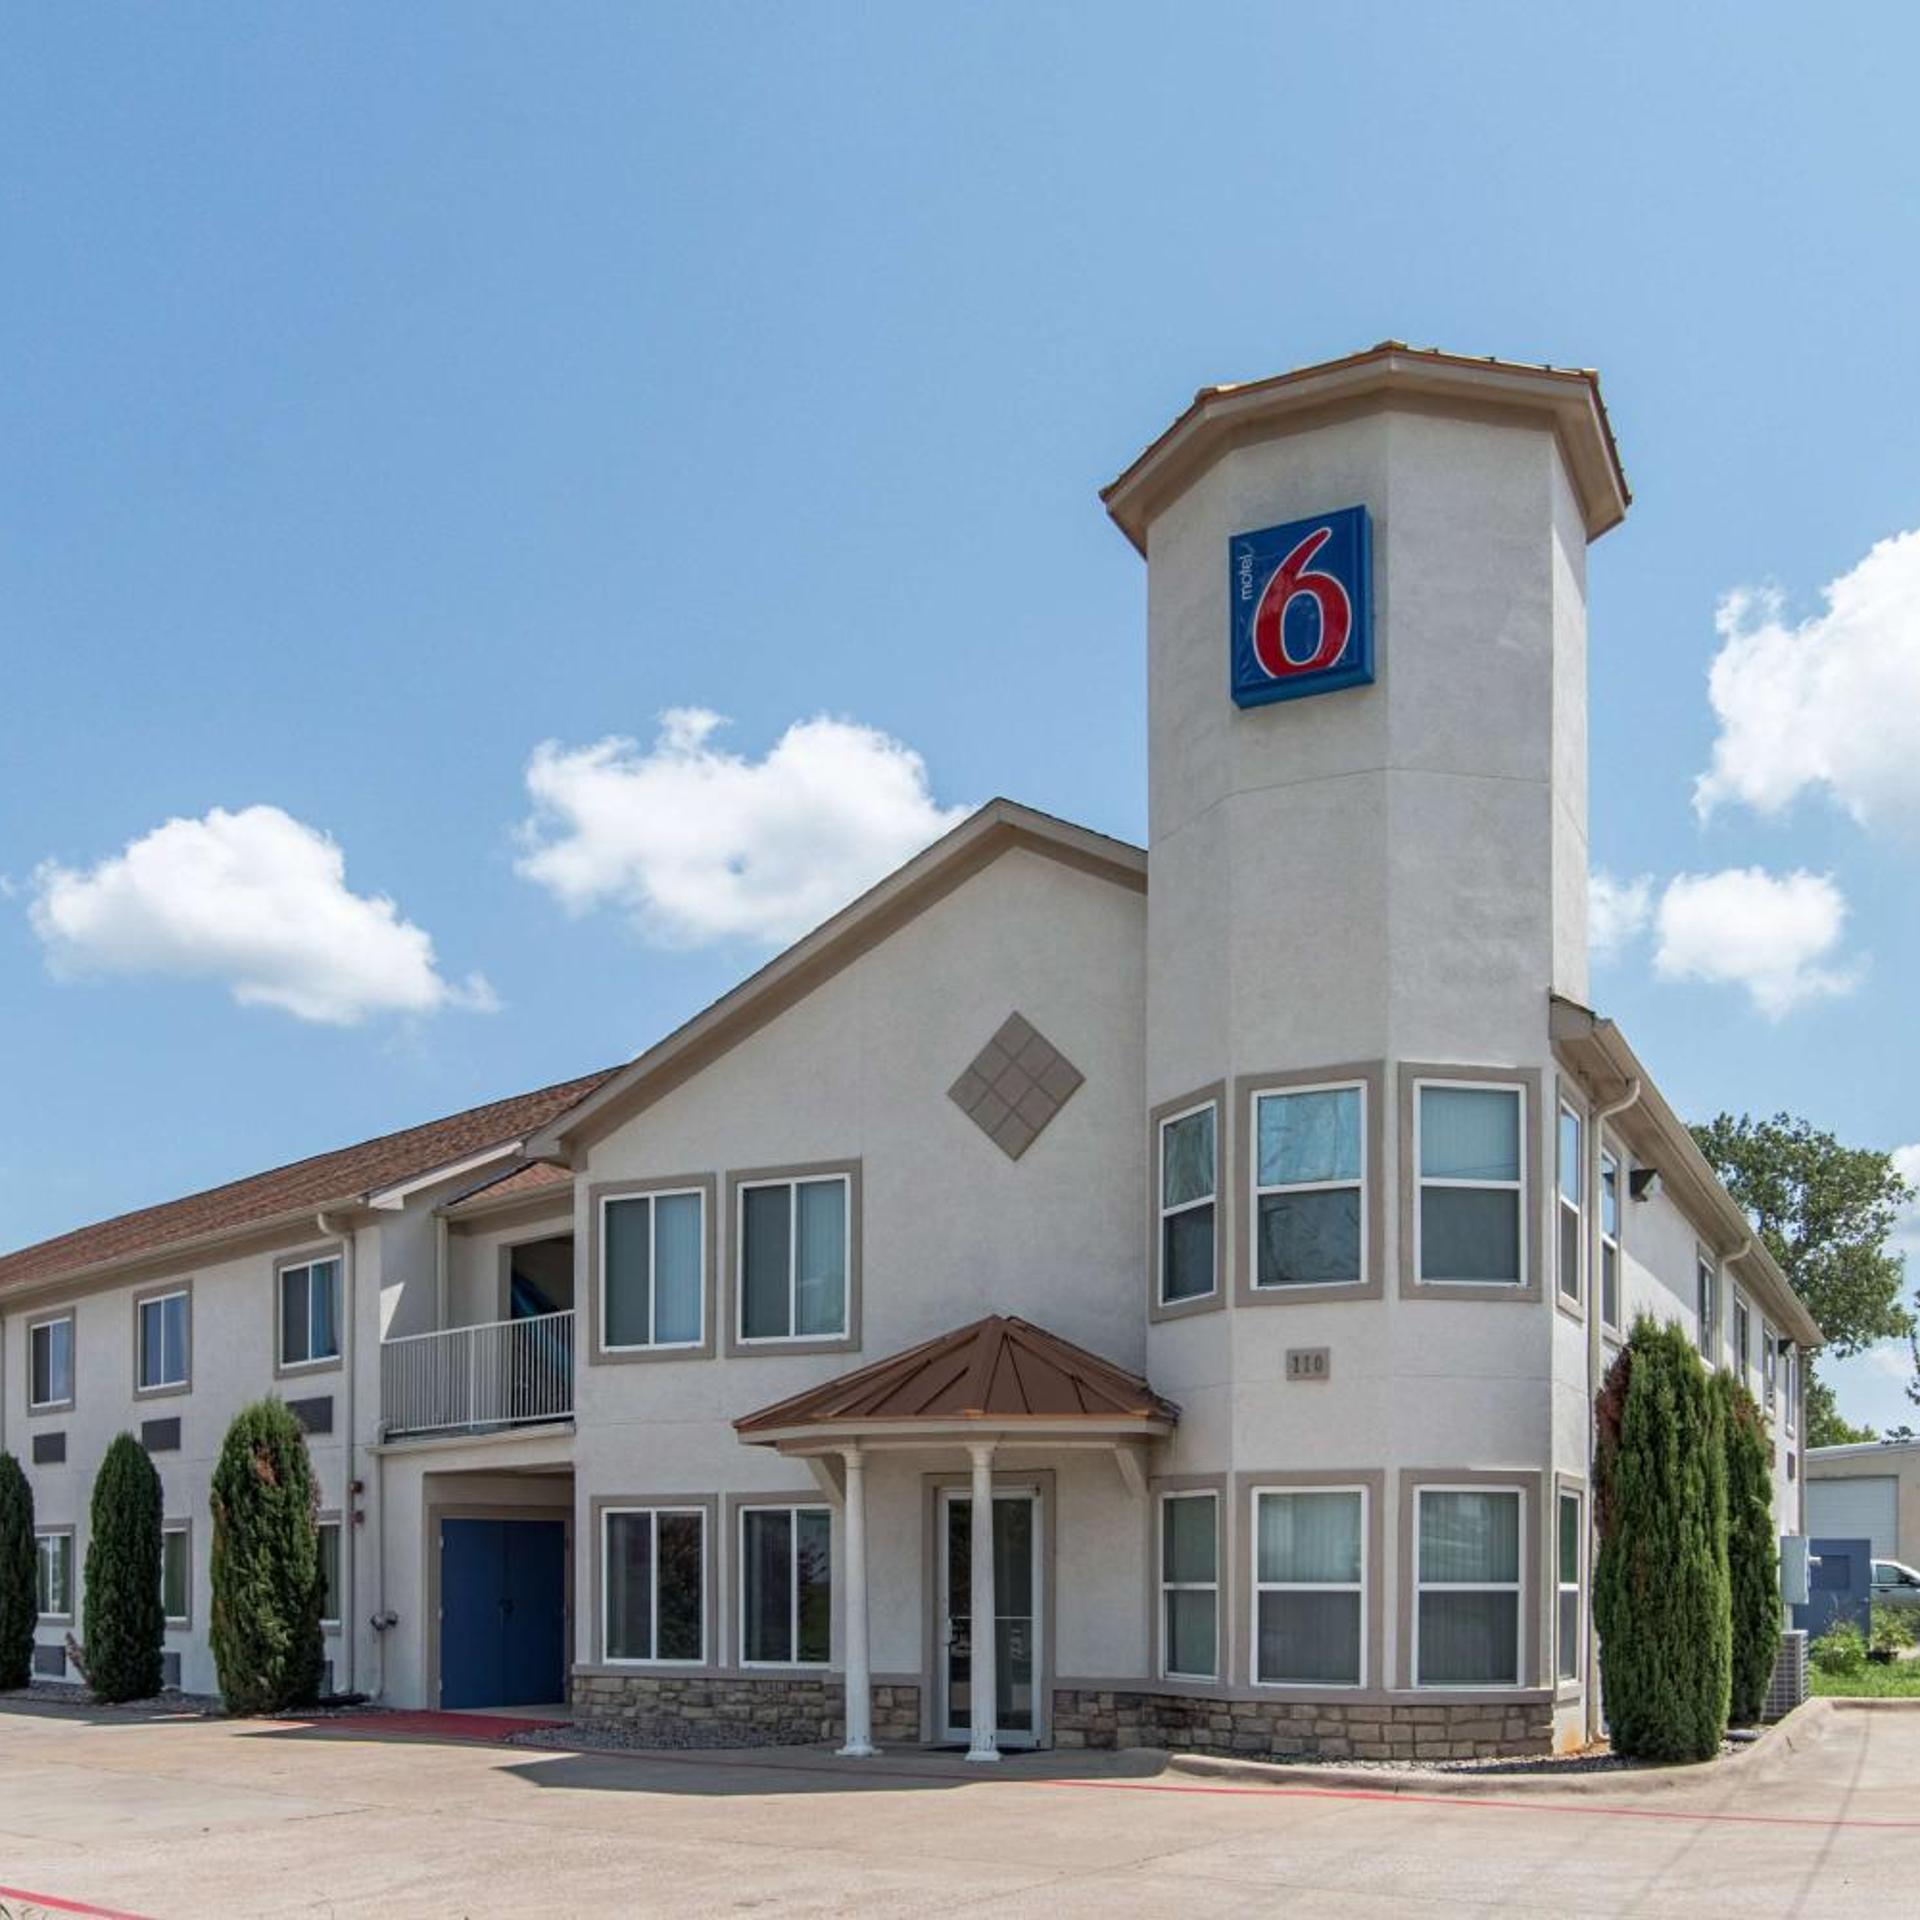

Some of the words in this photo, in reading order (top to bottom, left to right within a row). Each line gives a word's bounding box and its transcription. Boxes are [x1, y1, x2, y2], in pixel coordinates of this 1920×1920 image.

[1239, 553, 1253, 600] motel
[1253, 527, 1352, 679] 6
[1292, 1354, 1323, 1373] 110
